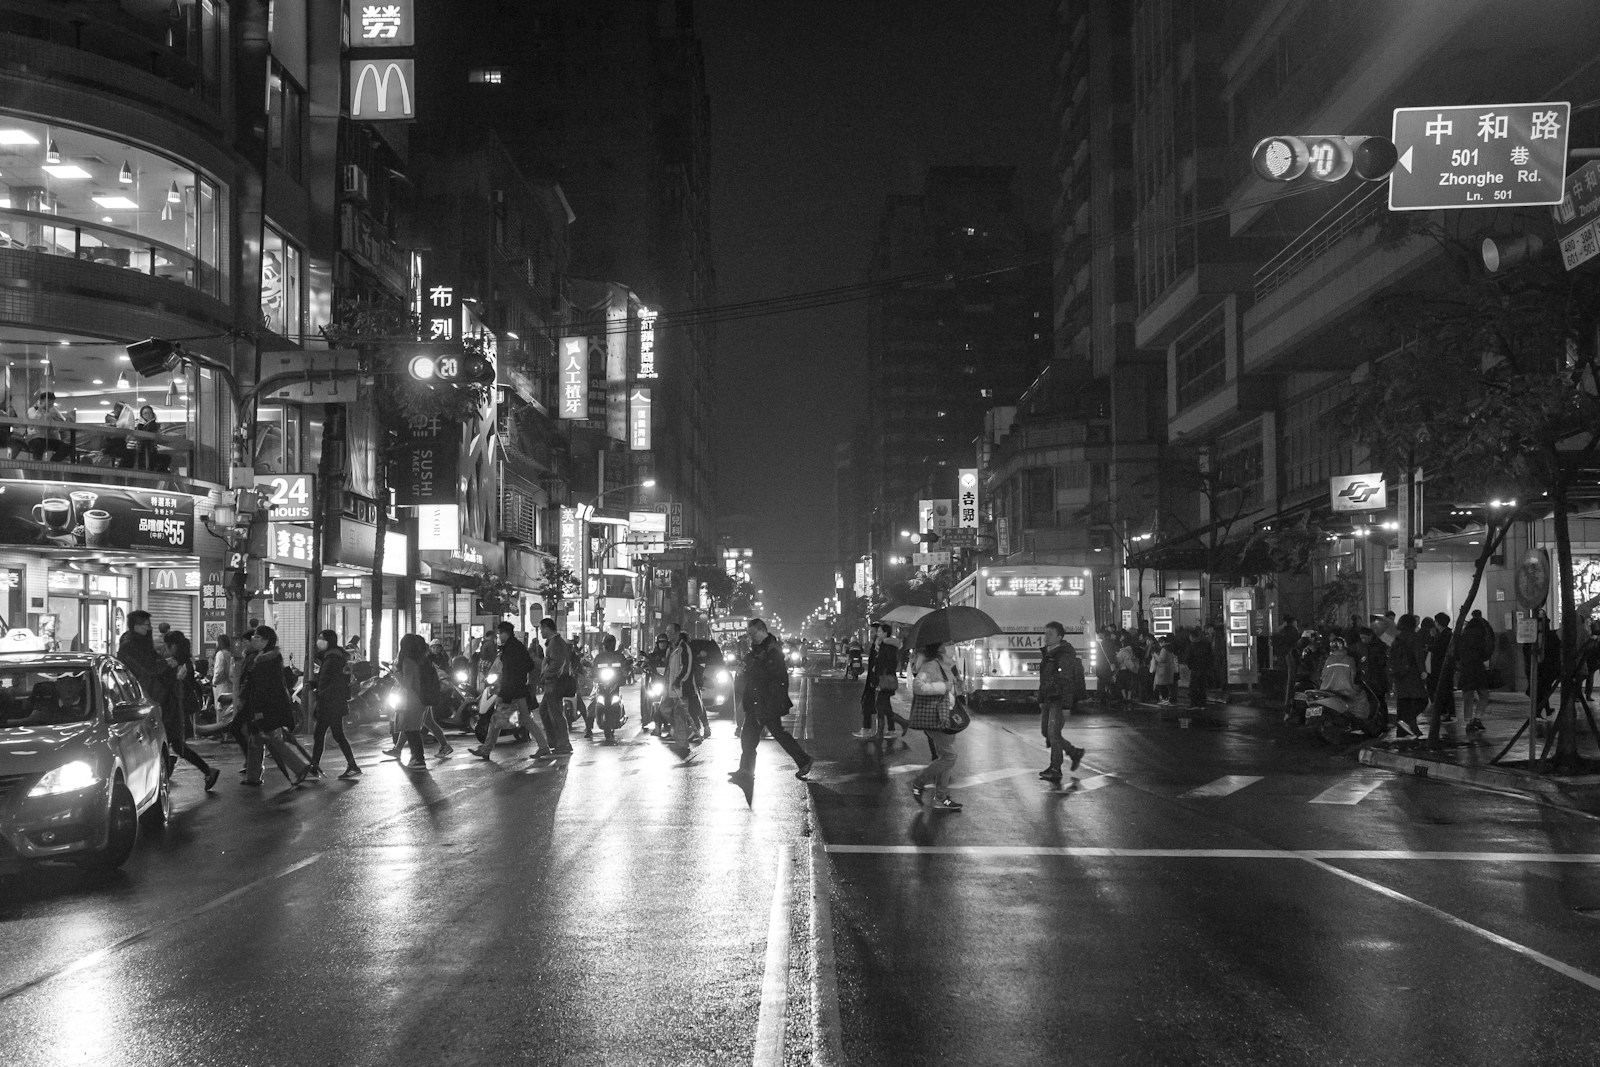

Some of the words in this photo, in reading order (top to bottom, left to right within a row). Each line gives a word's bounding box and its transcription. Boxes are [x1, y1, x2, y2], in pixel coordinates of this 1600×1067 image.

[362, 5, 401, 39] 勞
[1425, 111, 1561, 145] 中和路
[1451, 148, 1479, 167] 501
[1510, 146, 1530, 166] 巷
[1438, 171, 1504, 187] Zhonghe
[1517, 170, 1542, 183] Rd.
[1466, 191, 1484, 201] Ln.
[1494, 190, 1513, 200] 501
[1572, 164, 1600, 200] 中和
[430, 285, 453, 341] 布列
[441, 358, 458, 377] 20
[565, 356, 582, 413] 人工植牙
[412, 449, 420, 497] TAKE-UT
[421, 449, 433, 496] SUSHI
[270, 478, 309, 504] 24
[962, 492, 975, 528] 吉野
